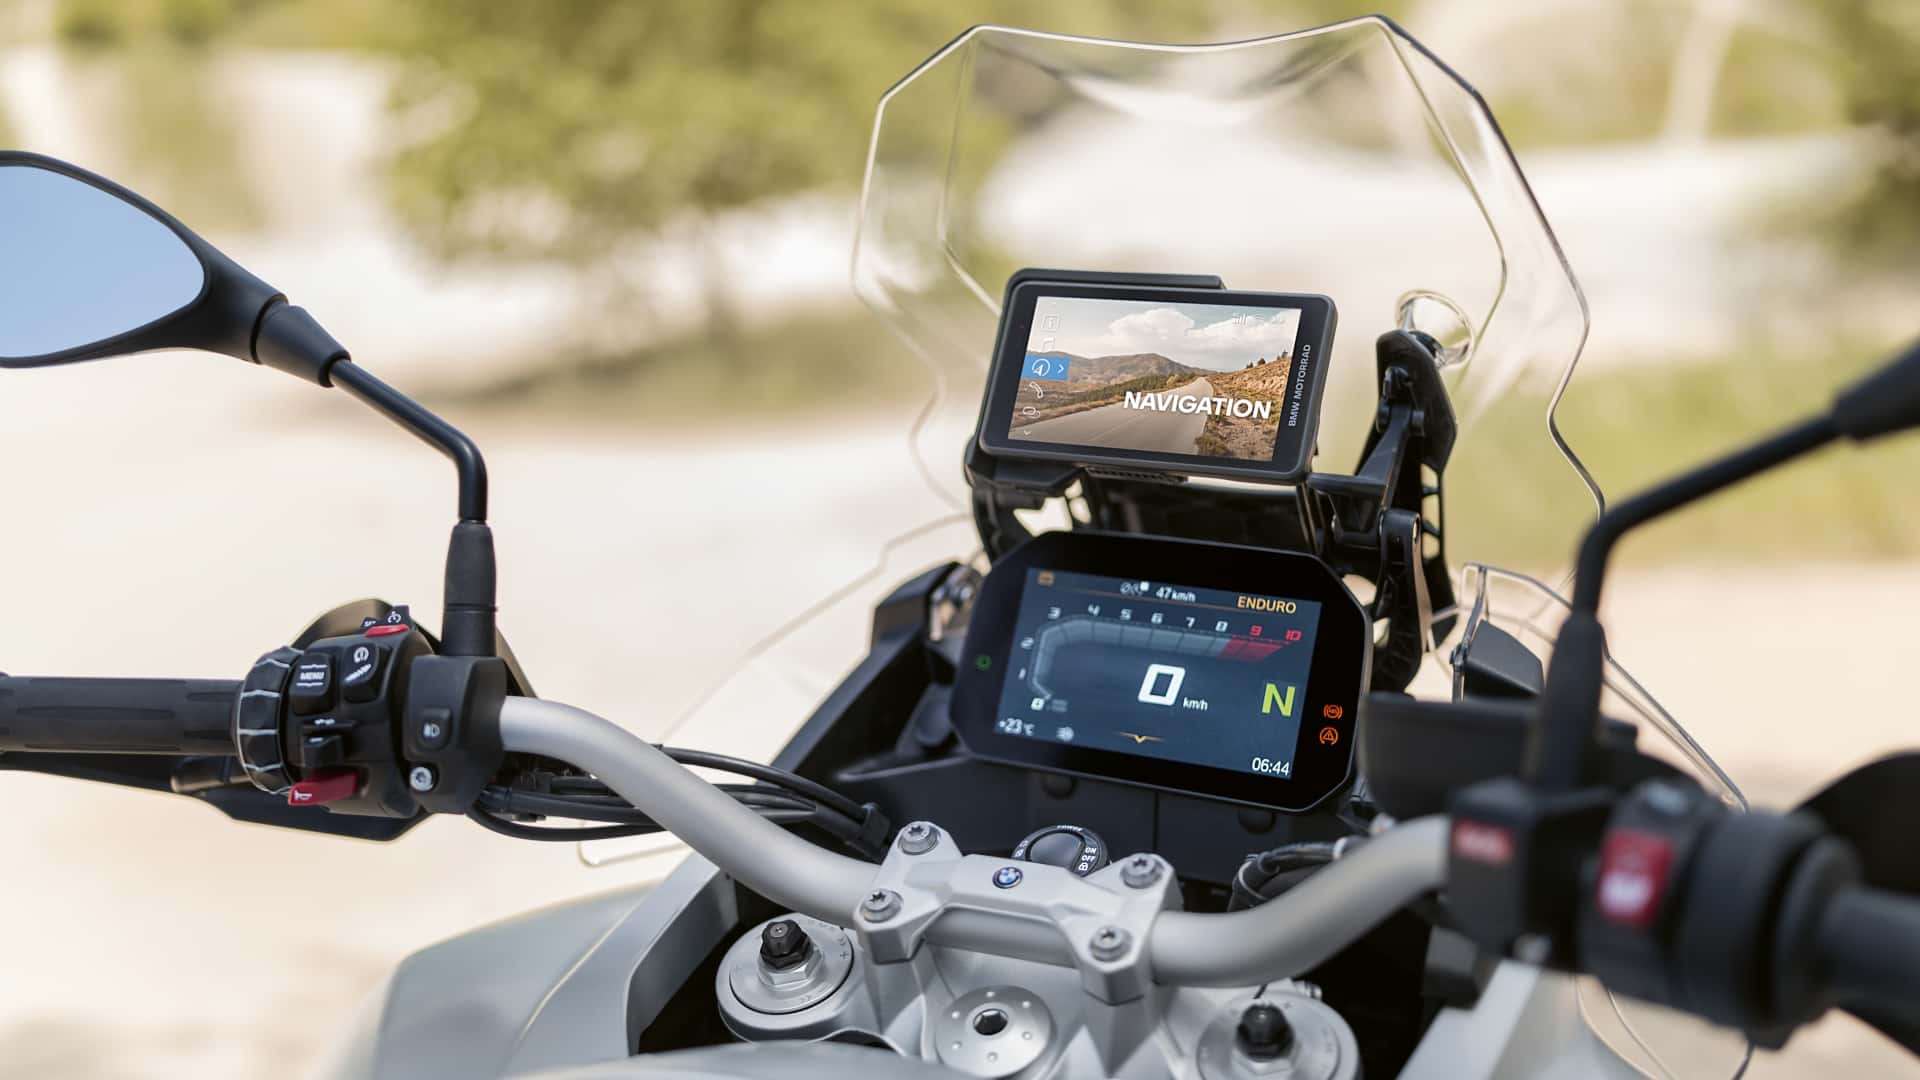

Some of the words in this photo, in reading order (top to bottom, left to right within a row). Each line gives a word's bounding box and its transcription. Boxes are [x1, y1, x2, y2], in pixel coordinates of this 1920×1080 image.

[1288, 402, 1301, 428] BMW
[1295, 344, 1312, 400] MOTORRAD
[1123, 390, 1272, 419] NAVIGATION
[1237, 595, 1297, 614] ENDURO
[1047, 607, 1061, 619] 3
[1088, 604, 1101, 616] 4
[1120, 608, 1132, 620] 5
[1151, 612, 1164, 624] 6
[1185, 616, 1196, 628] 7
[1215, 621, 1228, 633] 8
[1250, 625, 1263, 637] 9
[1285, 629, 1302, 641] 10
[300, 672, 325, 680] MENU
[1137, 663, 1186, 707] 0
[1183, 696, 1208, 712] km/h
[1261, 682, 1296, 717] N
[1251, 756, 1290, 777] 06:44
